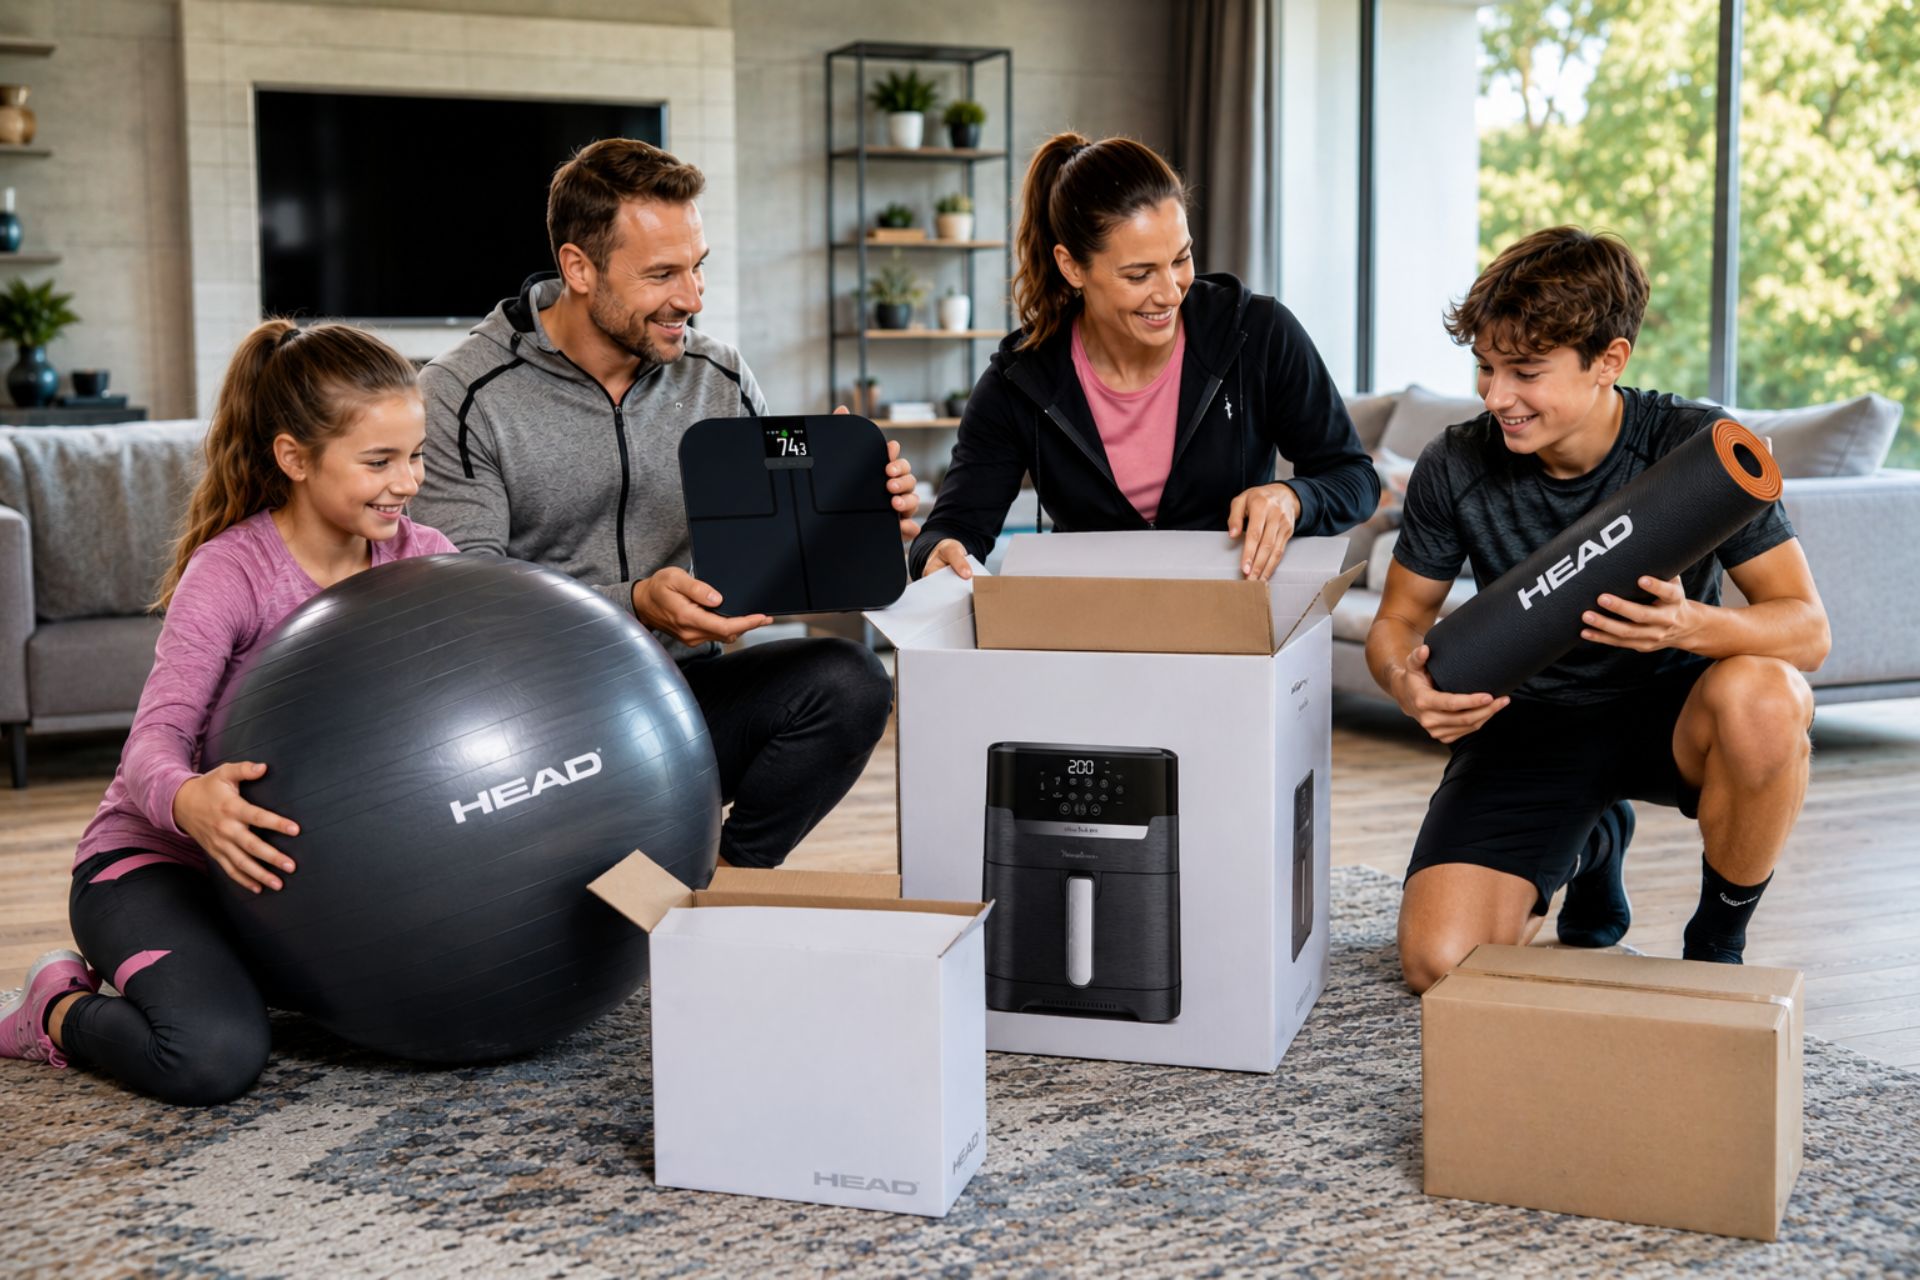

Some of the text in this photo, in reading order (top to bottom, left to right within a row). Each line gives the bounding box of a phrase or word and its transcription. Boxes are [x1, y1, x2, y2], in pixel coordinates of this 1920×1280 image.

[1517, 514, 1633, 611] HEAD
[450, 752, 602, 824] HEAD
[1068, 760, 1094, 774] 200
[953, 1132, 979, 1176] HEAD
[814, 1171, 918, 1196] HEAD
